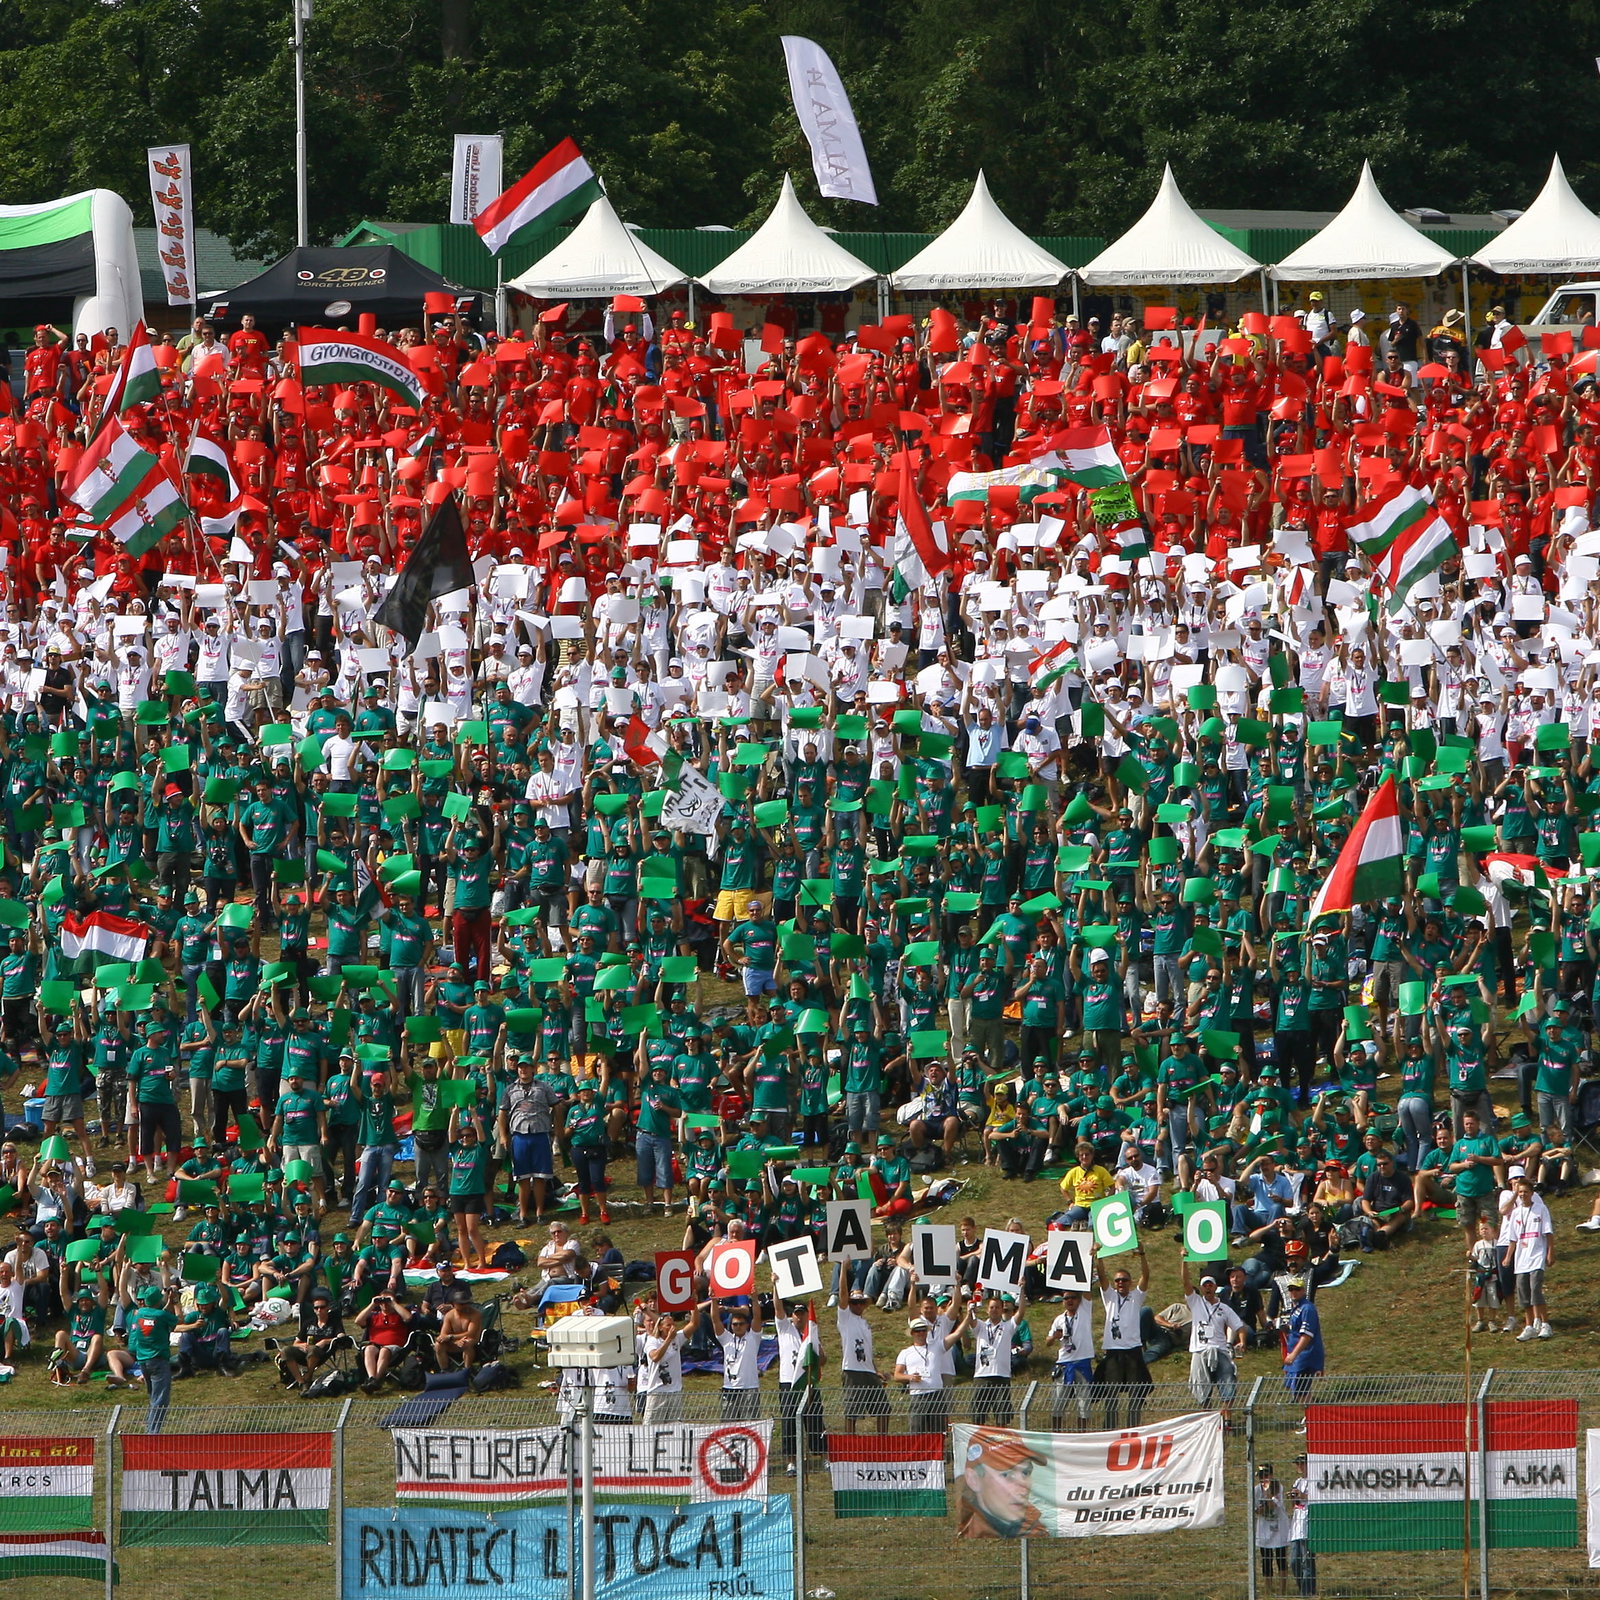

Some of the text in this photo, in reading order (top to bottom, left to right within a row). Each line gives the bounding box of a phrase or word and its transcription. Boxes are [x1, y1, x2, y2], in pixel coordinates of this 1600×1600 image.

[298, 279, 385, 288] JORGE LORENZO
[317, 268, 368, 281] 48
[1106, 1432, 1174, 1472] Öli
[857, 1467, 927, 1482] SZENTES
[1316, 1464, 1465, 1491] JÁNOSHÁZA
[1503, 1465, 1566, 1486] AJKA
[161, 1470, 297, 1510] TALMA
[1067, 1477, 1213, 1501] du fehlst uns!
[1074, 1504, 1195, 1523] Deine Fans.
[361, 1525, 516, 1587] RIDATECI
[594, 1512, 743, 1583] TOCAI
